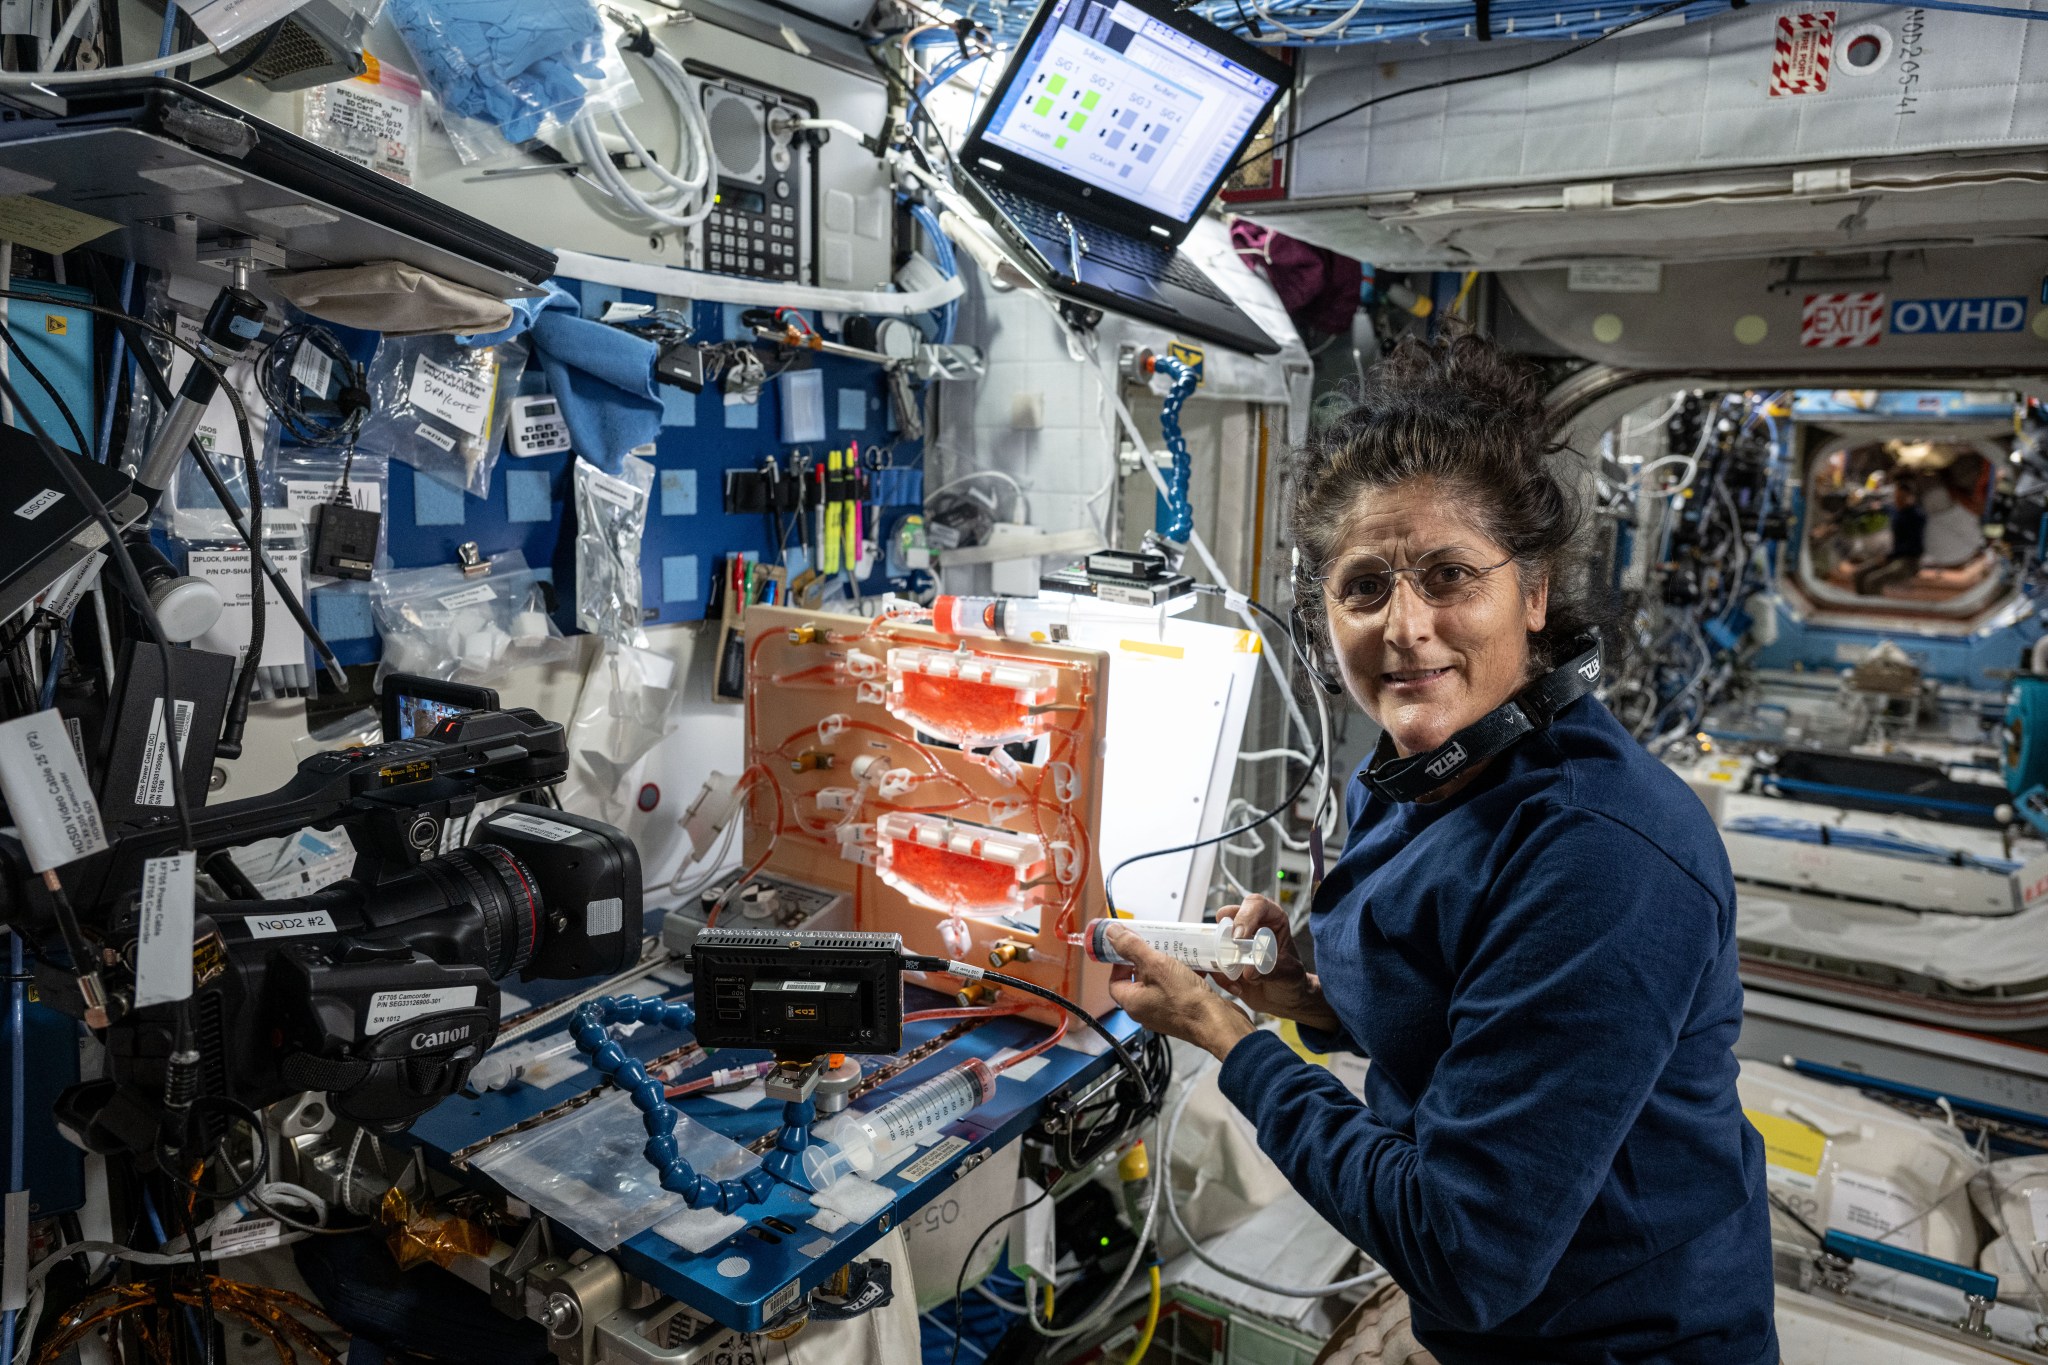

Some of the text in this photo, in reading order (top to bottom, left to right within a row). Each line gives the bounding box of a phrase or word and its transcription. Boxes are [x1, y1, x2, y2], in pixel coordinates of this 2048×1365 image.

[1055, 57, 1074, 73] S/G
[1798, 31, 1810, 77] FIRE PORT
[1090, 73, 1109, 88] S/G
[337, 88, 383, 108] RFID Logistics
[345, 98, 356, 106] SD
[356, 102, 374, 113] Card
[1128, 92, 1147, 107] S/G
[1159, 107, 1177, 121] S/G
[1813, 306, 1874, 334] EXIT
[1895, 301, 2024, 333] OVHD
[198, 424, 217, 434] USOS
[23, 491, 57, 516] SSC10
[56, 594, 69, 614] ZBook
[67, 578, 80, 596] Power
[77, 563, 90, 581] Cable
[48, 599, 58, 610] P1
[68, 593, 80, 610] ZBook
[1577, 658, 1600, 680] ETZL
[136, 733, 157, 804] ZBook Power Cable (DC)
[1424, 741, 1468, 777] PETZL
[26, 730, 85, 855] HDSDI Video Cable 25' (P2)
[58, 771, 82, 813] Camcorder
[82, 800, 94, 816] SDI
[170, 859, 181, 873] P1
[142, 861, 157, 944] To XF705 Camcorder
[153, 860, 168, 937] XF705 Power Cable
[257, 915, 327, 932] NOD2 #2
[398, 992, 432, 1000] Camcorder
[410, 1024, 470, 1051] Canon
[842, 1281, 884, 1312] PETZL
